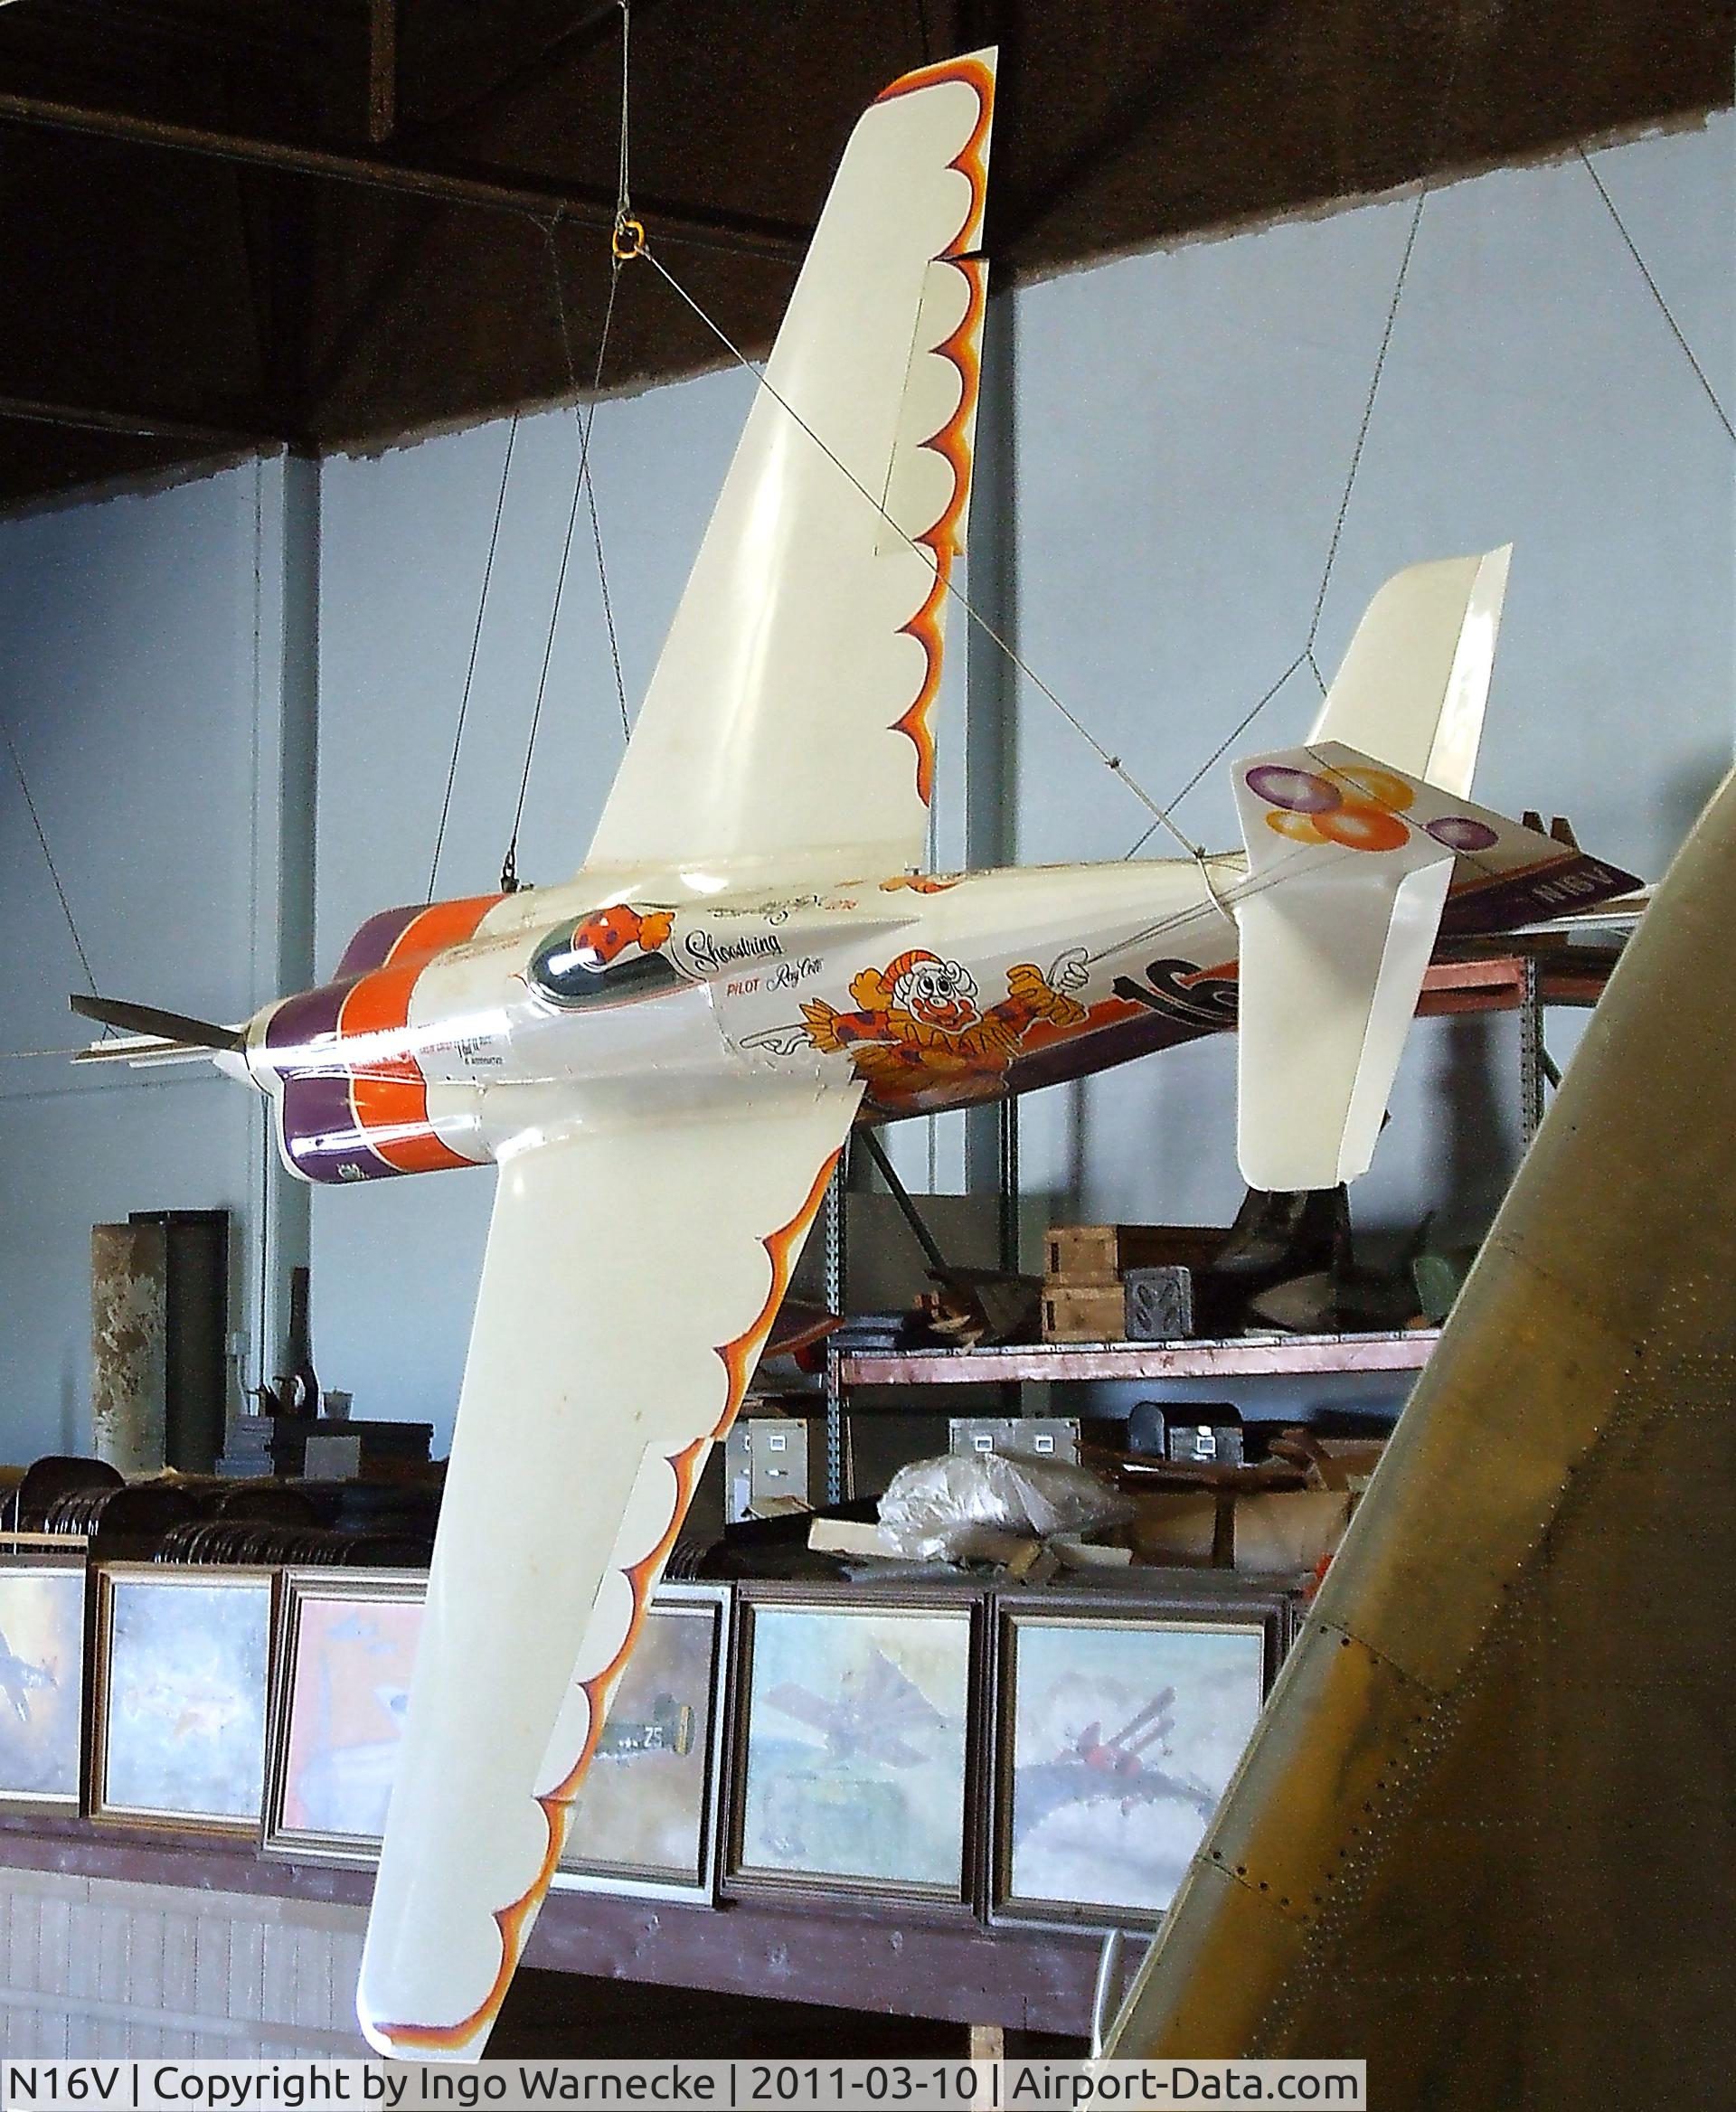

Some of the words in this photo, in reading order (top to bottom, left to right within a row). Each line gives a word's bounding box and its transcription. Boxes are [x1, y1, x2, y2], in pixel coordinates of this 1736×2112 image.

[1532, 864, 1618, 903] N16V
[684, 929, 785, 972] Shoestring
[727, 978, 760, 997] PILOT
